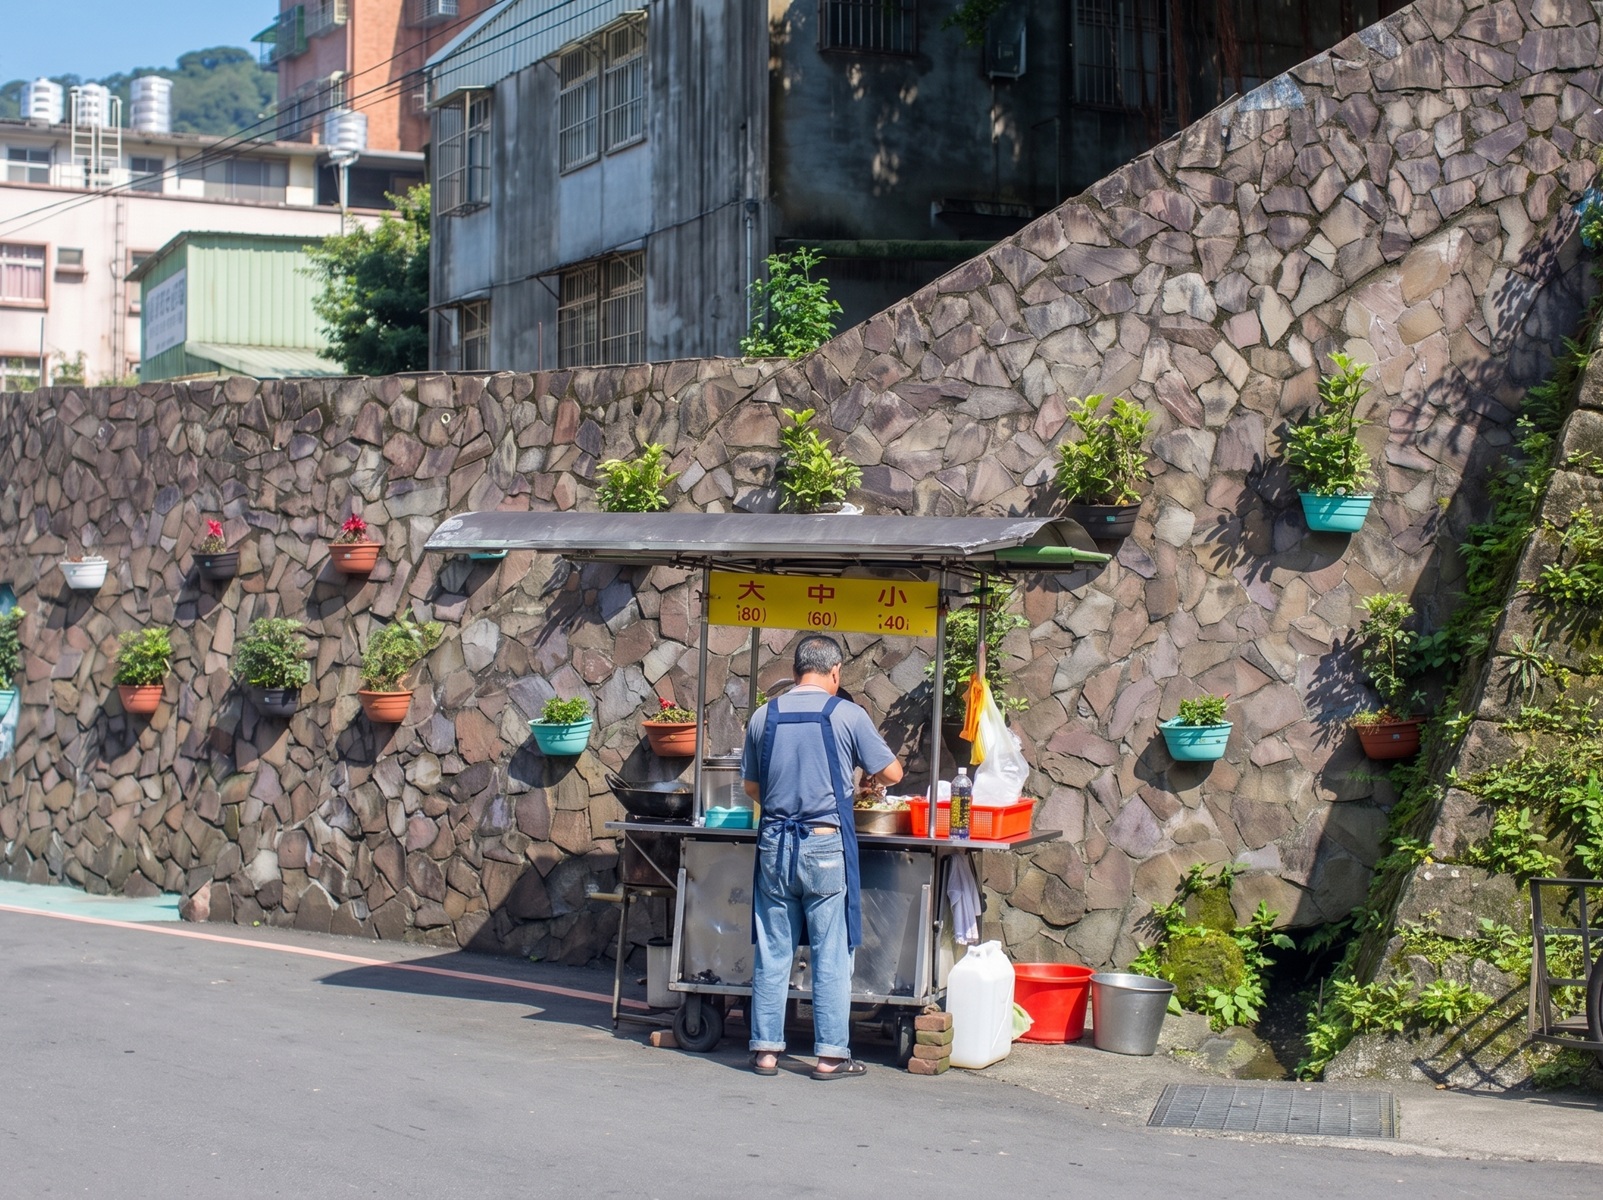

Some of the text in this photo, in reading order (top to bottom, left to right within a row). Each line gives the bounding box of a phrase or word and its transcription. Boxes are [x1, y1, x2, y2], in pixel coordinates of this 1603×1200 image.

[737, 580, 907, 607] 大 中 小
[808, 610, 838, 629] (60)
